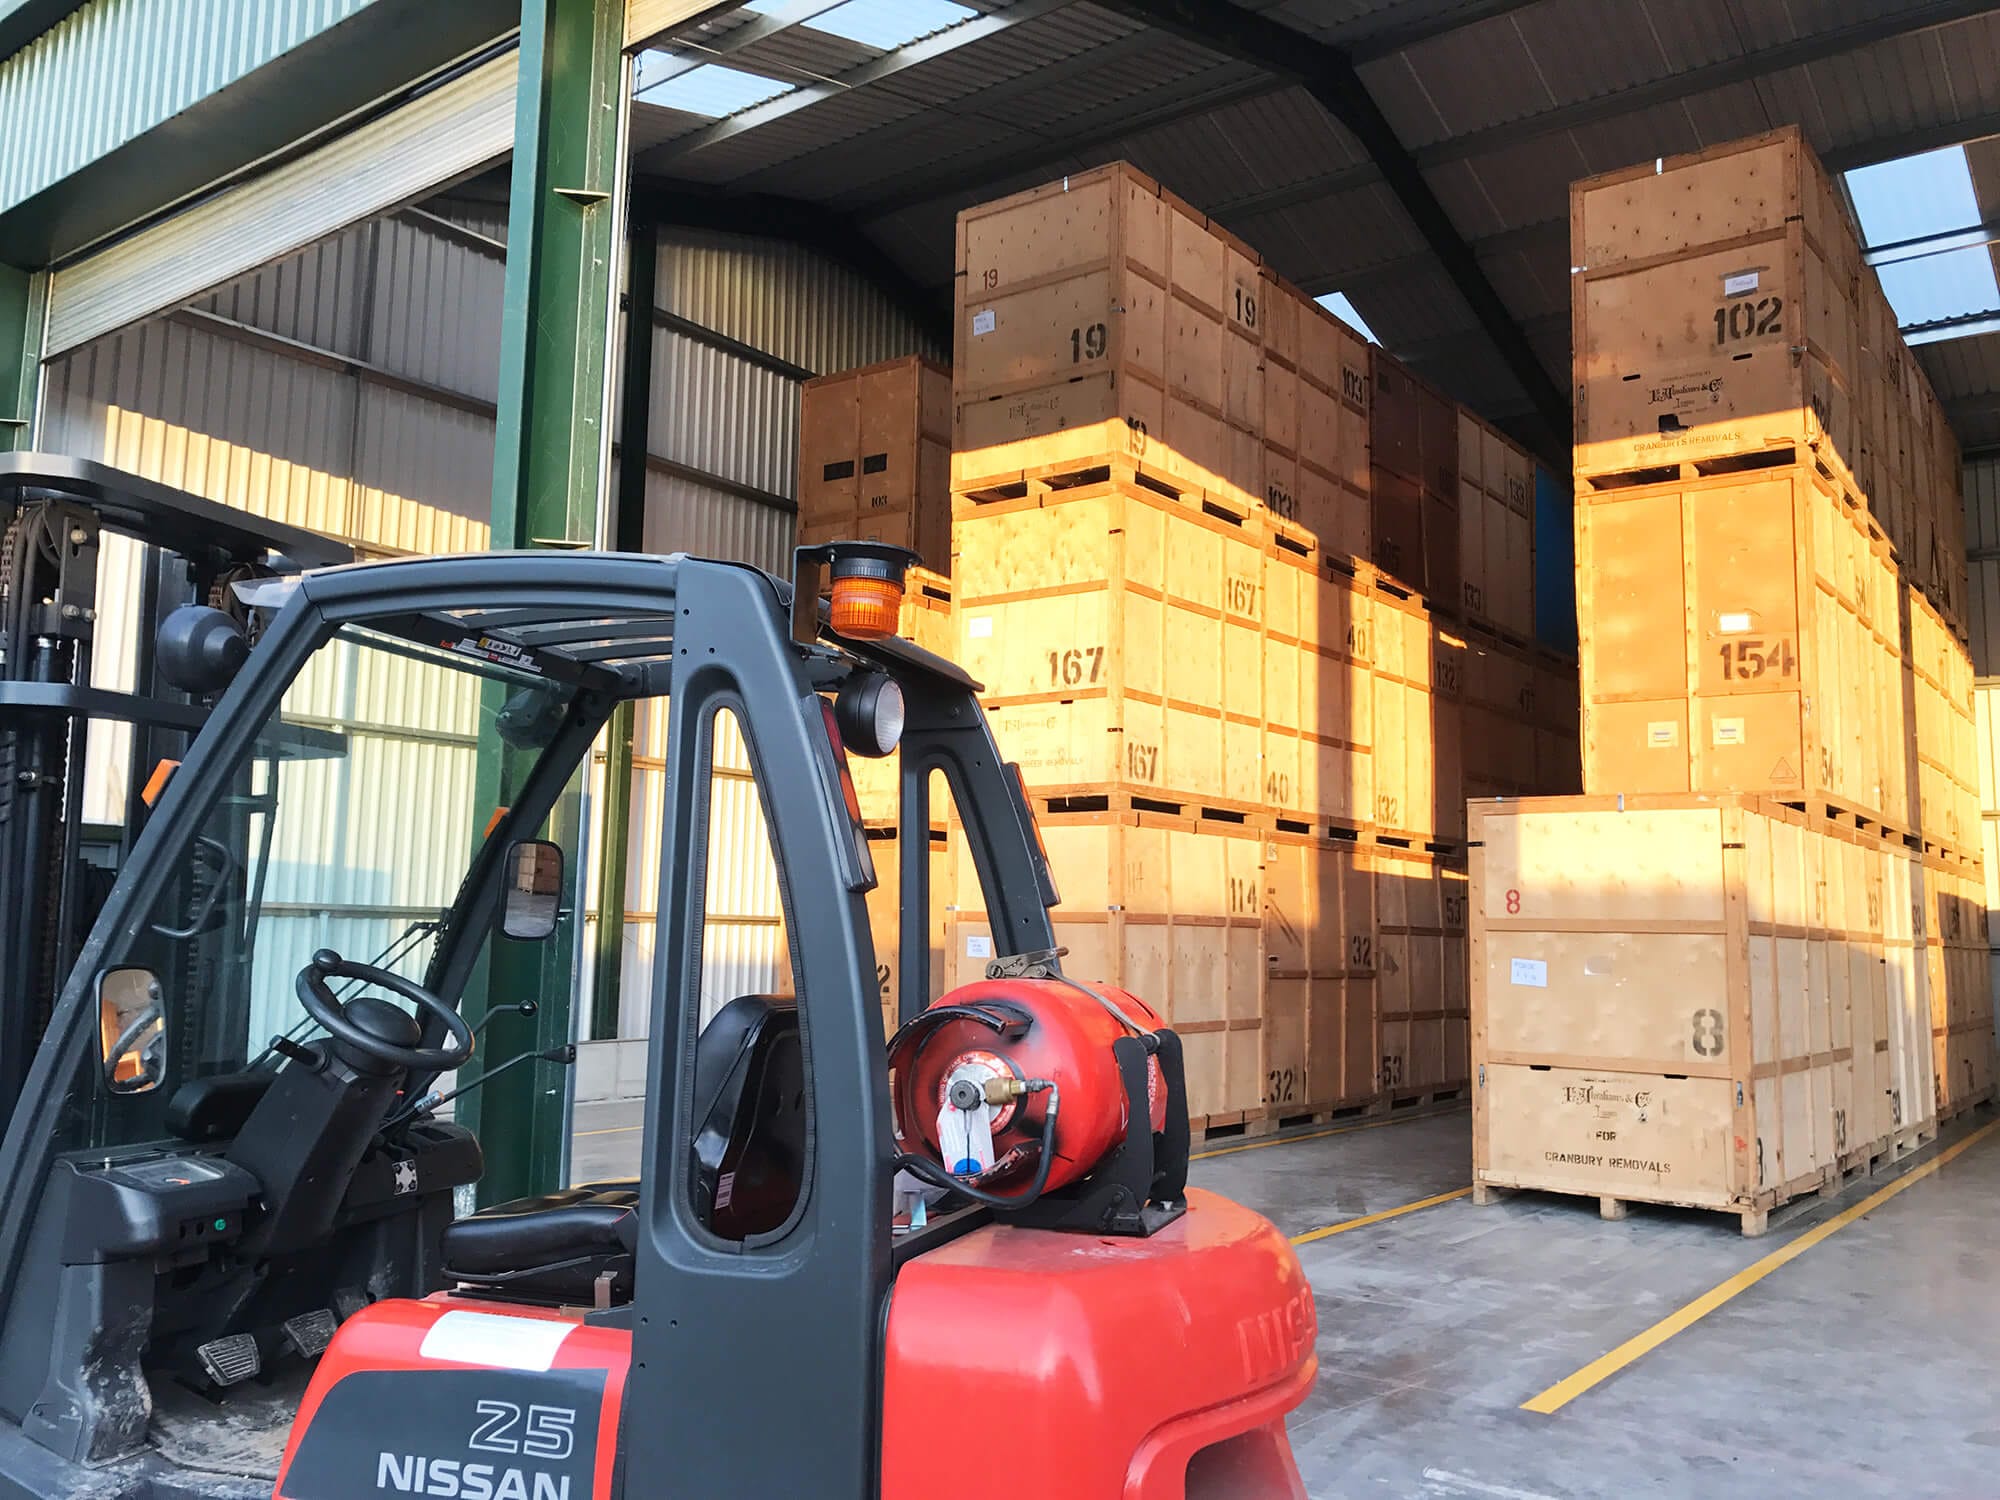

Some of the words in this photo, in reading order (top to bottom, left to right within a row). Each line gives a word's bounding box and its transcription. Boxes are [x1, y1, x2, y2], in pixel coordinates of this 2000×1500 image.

[982, 268, 998, 290] 19
[1234, 287, 1257, 328] 19
[1714, 296, 1783, 345] 102
[1069, 322, 1107, 364] 19
[1127, 415, 1148, 457] 19
[1226, 576, 1257, 616] 167
[1048, 646, 1105, 688] 167
[1719, 638, 1795, 681] 154
[1127, 742, 1159, 783] 167
[1266, 770, 1290, 804] 40
[1230, 877, 1257, 914] 114
[1505, 888, 1521, 915] 8
[1352, 935, 1371, 967] 32
[1691, 1007, 1725, 1057] 8
[1269, 1069, 1293, 1103] 32
[1382, 1055, 1402, 1086] 53
[1595, 1130, 1617, 1142] FOR
[1544, 1151, 1603, 1168] CRANBURY
[1608, 1157, 1672, 1174] REMOVALS
[468, 1400, 576, 1460] 25
[376, 1452, 571, 1500] NISSAN
